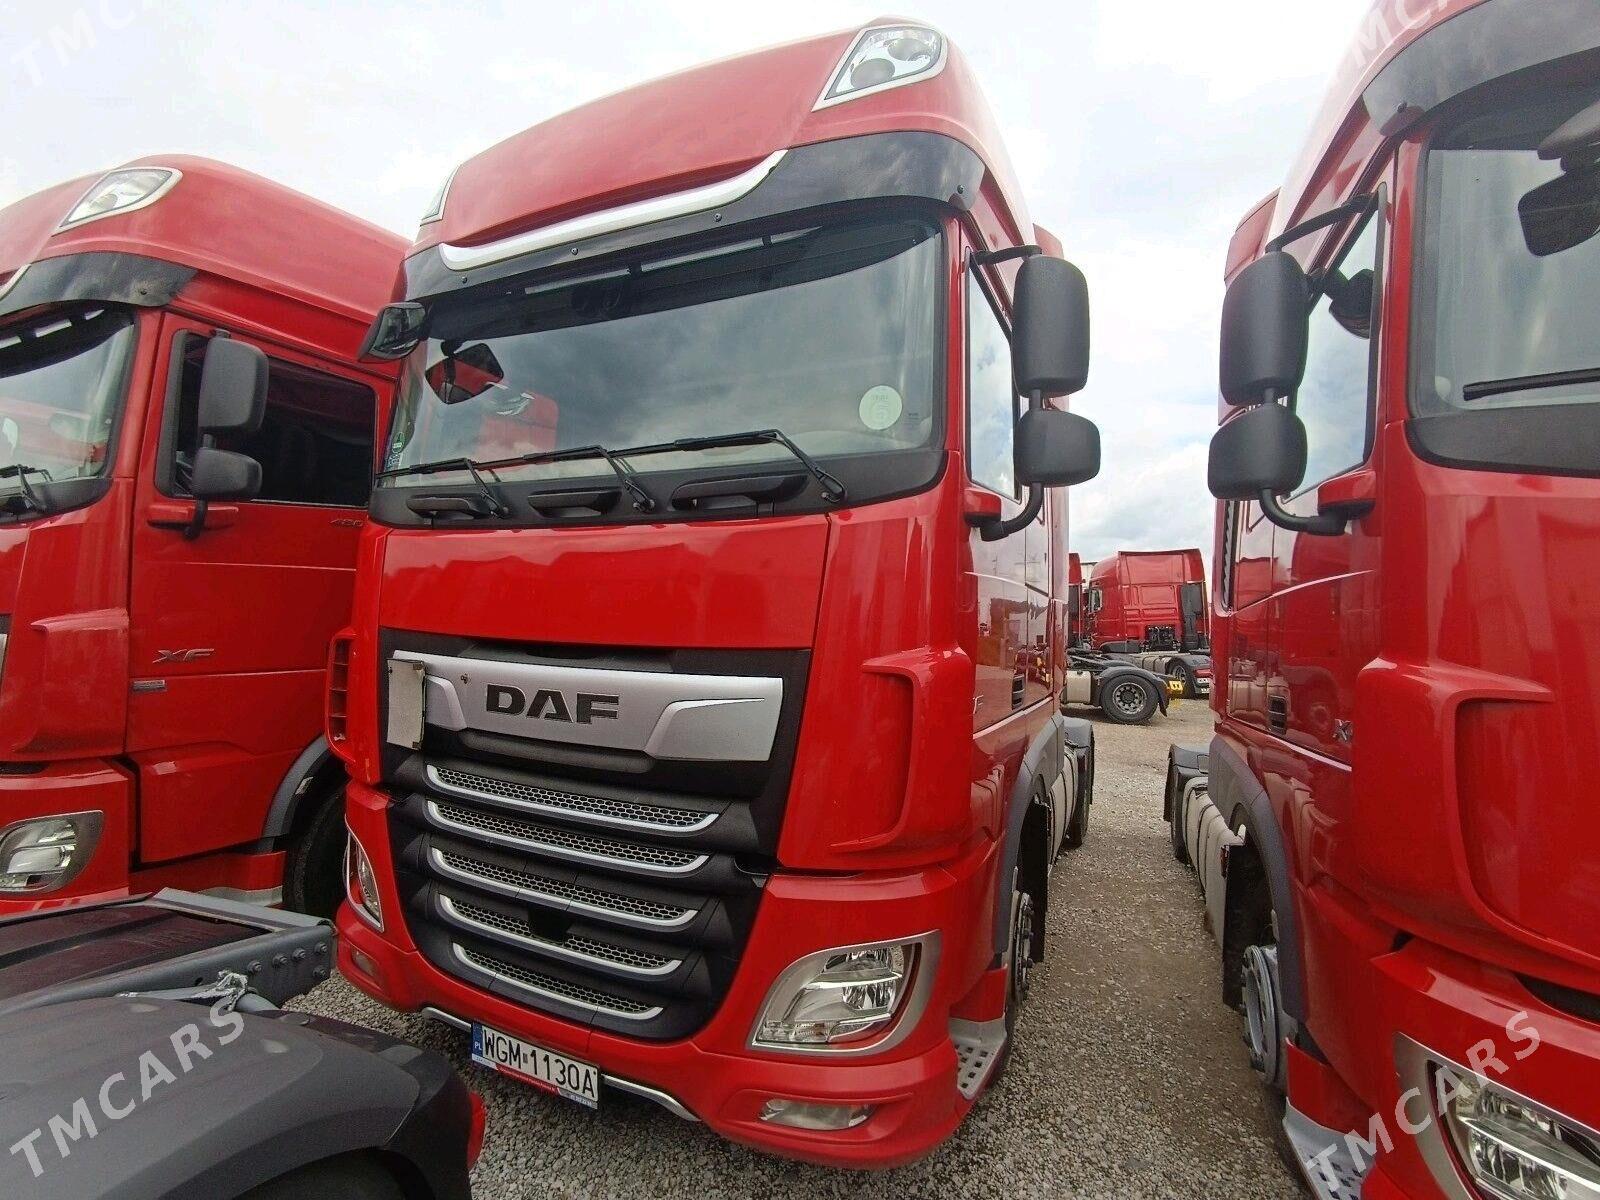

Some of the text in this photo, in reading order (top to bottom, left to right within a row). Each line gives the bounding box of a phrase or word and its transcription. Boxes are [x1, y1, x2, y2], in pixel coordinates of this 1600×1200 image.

[152, 648, 215, 664] XF
[486, 683, 620, 725] DAF
[474, 1040, 483, 1052] PL
[484, 1029, 522, 1070] WGM
[530, 1049, 595, 1098] 1130A
